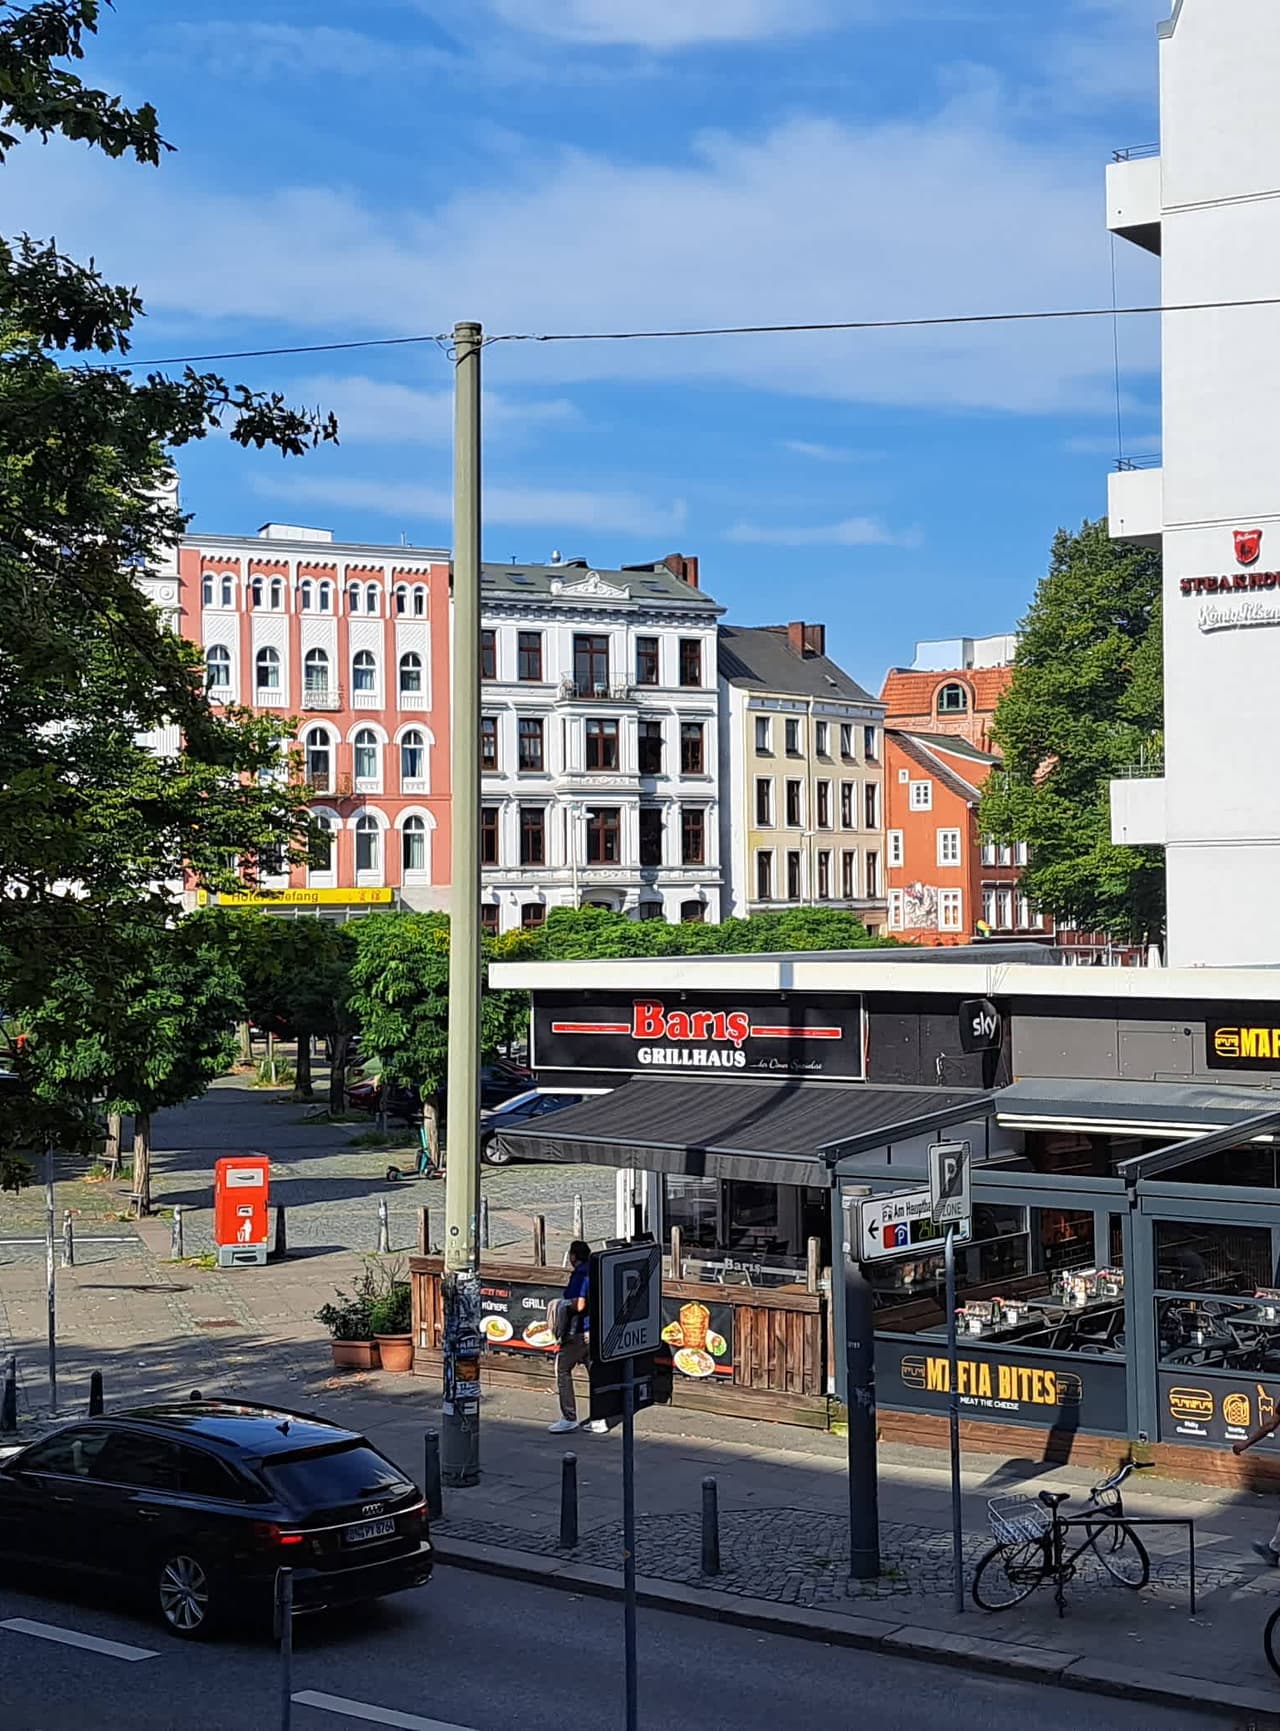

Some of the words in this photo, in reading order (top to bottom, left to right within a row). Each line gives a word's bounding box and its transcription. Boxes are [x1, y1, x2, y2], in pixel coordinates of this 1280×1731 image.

[972, 1010, 997, 1039] sky
[637, 1046, 746, 1068] GRILLHAUS
[522, 1297, 547, 1309] GRILL
[998, 1364, 1057, 1405] BITES
[980, 1399, 993, 1407] THE
